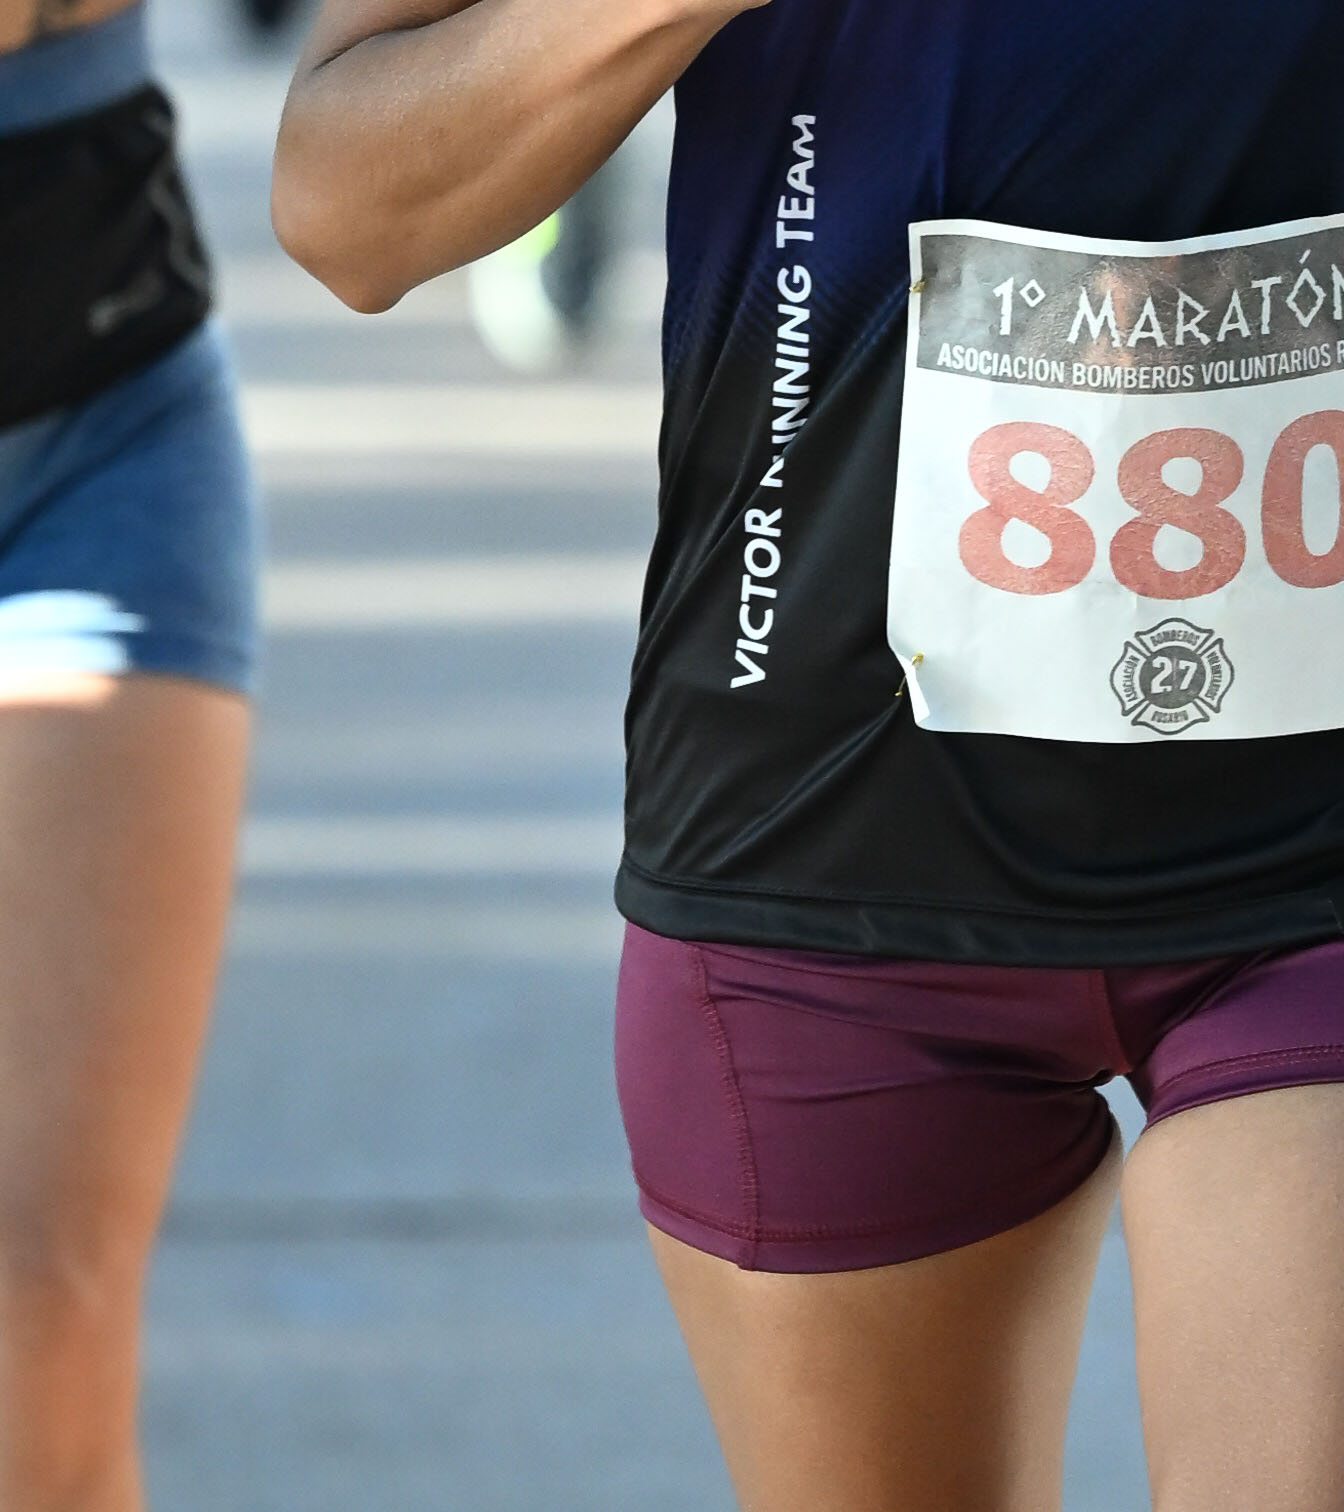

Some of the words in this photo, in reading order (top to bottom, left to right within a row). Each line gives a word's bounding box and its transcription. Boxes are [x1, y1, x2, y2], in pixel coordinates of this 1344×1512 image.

[936, 343, 1064, 382] ASOCIACIÓN
[1072, 361, 1195, 389] BOMBEROS
[1201, 343, 1332, 386] VOLUNTARIOS
[730, 508, 782, 690] VICTOR
[776, 113, 815, 248] TEAM
[1150, 655, 1198, 694] 27
